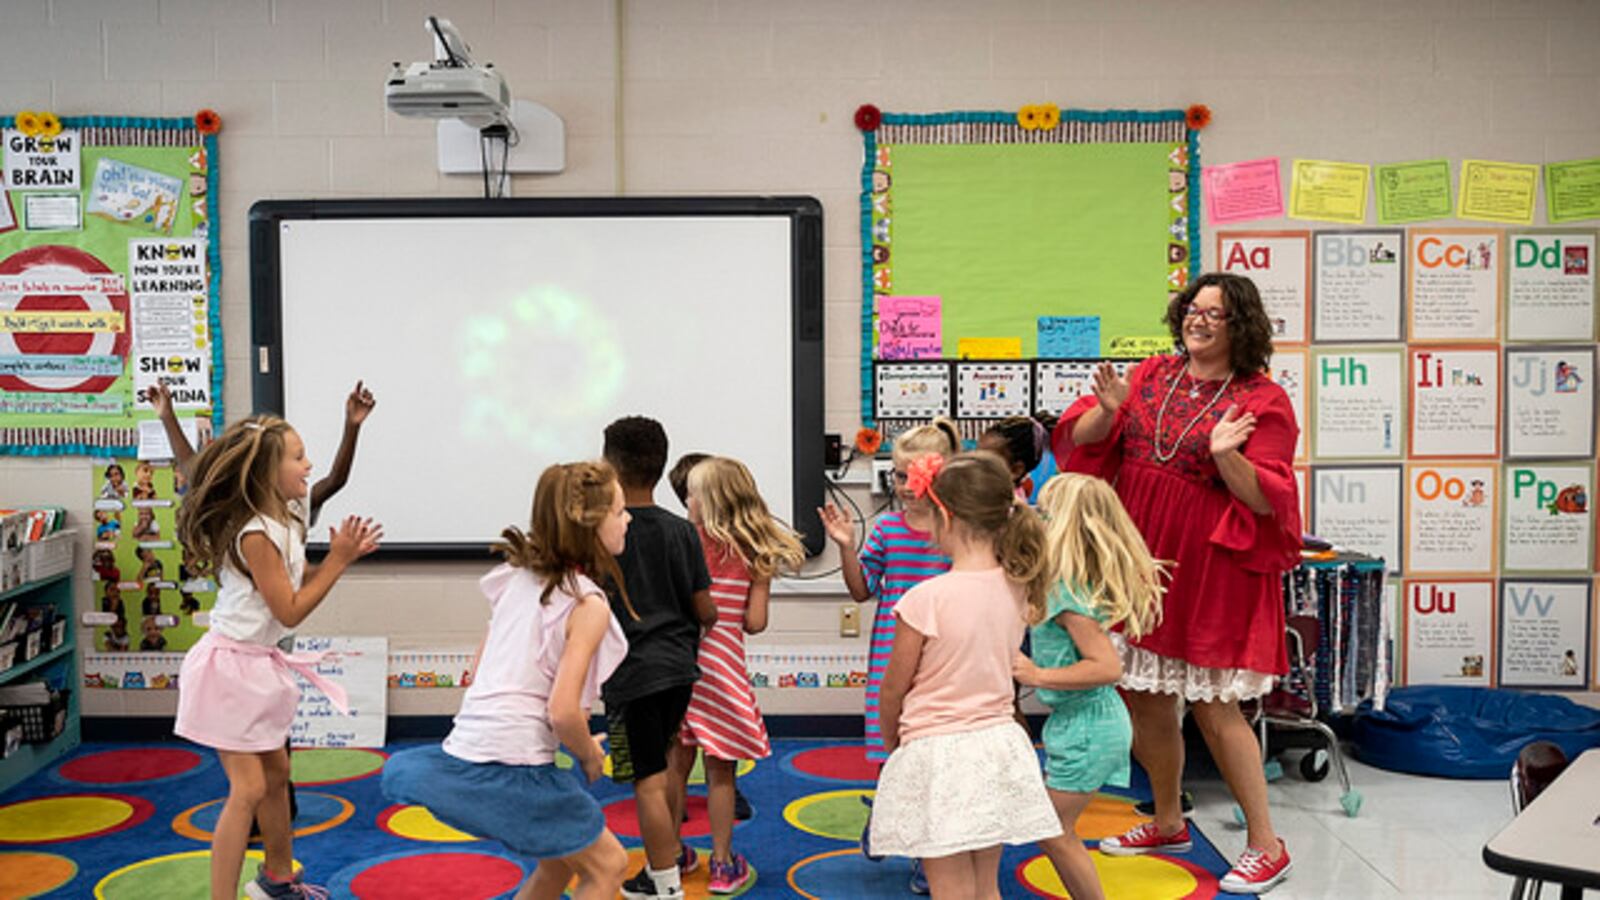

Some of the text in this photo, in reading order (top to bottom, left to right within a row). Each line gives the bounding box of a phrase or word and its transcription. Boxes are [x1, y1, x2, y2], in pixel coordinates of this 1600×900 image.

[10, 136, 72, 153] GROW
[29, 156, 58, 166] YOUR
[12, 169, 74, 185] BRAIN
[137, 244, 197, 261] KNOW
[1225, 242, 1270, 271] Aa
[1322, 238, 1366, 267] Bb
[1417, 237, 1466, 268] Cc
[1516, 238, 1561, 268] Dd
[135, 265, 199, 276] HOW YOU'RE
[134, 280, 204, 293] LEARNING
[140, 357, 201, 373] SHOW
[972, 371, 1014, 382] Accuracy
[1322, 357, 1367, 386] Hh
[1417, 353, 1443, 388] Ii
[1512, 356, 1547, 397] Jj
[137, 390, 206, 403] SMINA
[1321, 475, 1366, 503] Nn
[1416, 469, 1466, 501] Oo
[1514, 469, 1558, 510] Pp
[1414, 585, 1455, 614] Uu
[1509, 587, 1555, 617] Vv
